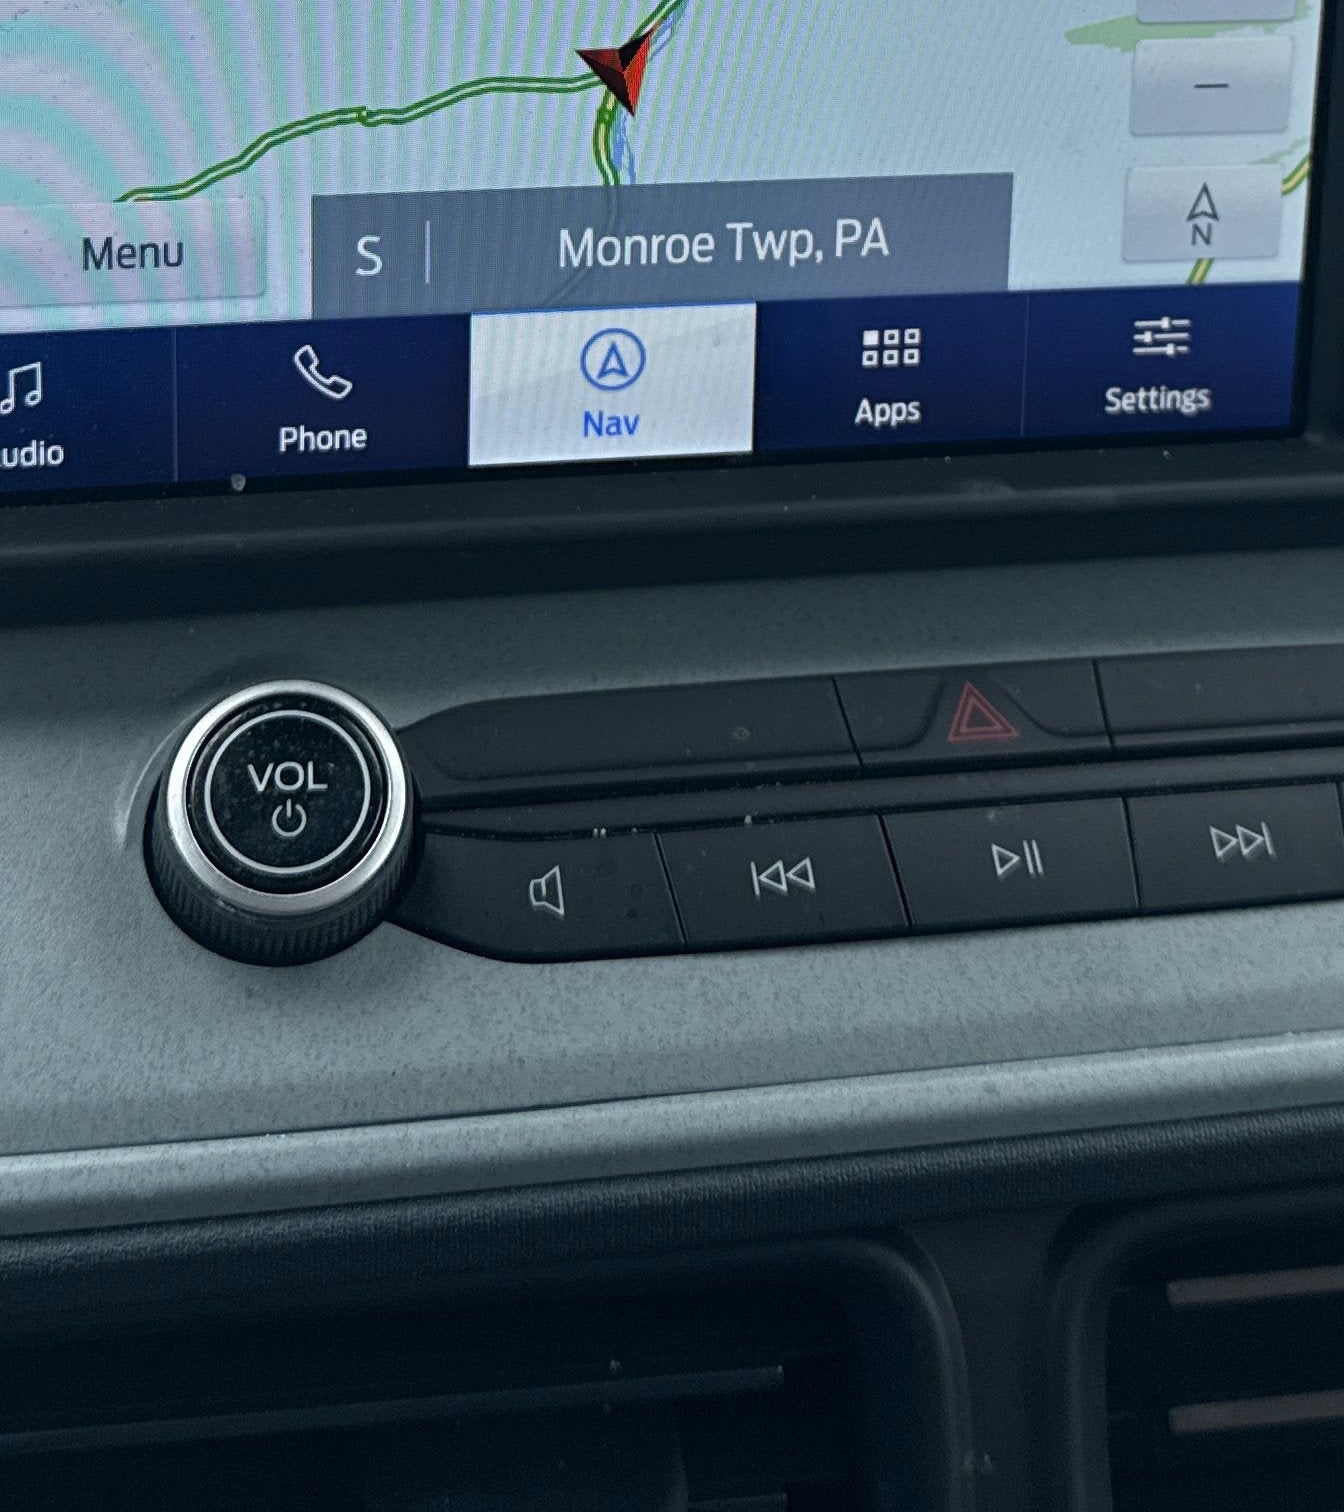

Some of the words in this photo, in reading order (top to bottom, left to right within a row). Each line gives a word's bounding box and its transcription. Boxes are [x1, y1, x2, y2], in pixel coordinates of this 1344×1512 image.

[558, 227, 715, 268] Monroe
[726, 219, 824, 266] Twp,
[835, 216, 890, 256] PA
[1191, 223, 1212, 245] N
[81, 236, 184, 272] Menu
[356, 235, 383, 276] S
[855, 397, 922, 427] Apps
[1104, 385, 1211, 415] Settings
[582, 409, 640, 438] Nav
[279, 426, 368, 453] Phone
[247, 760, 329, 793] VOL
